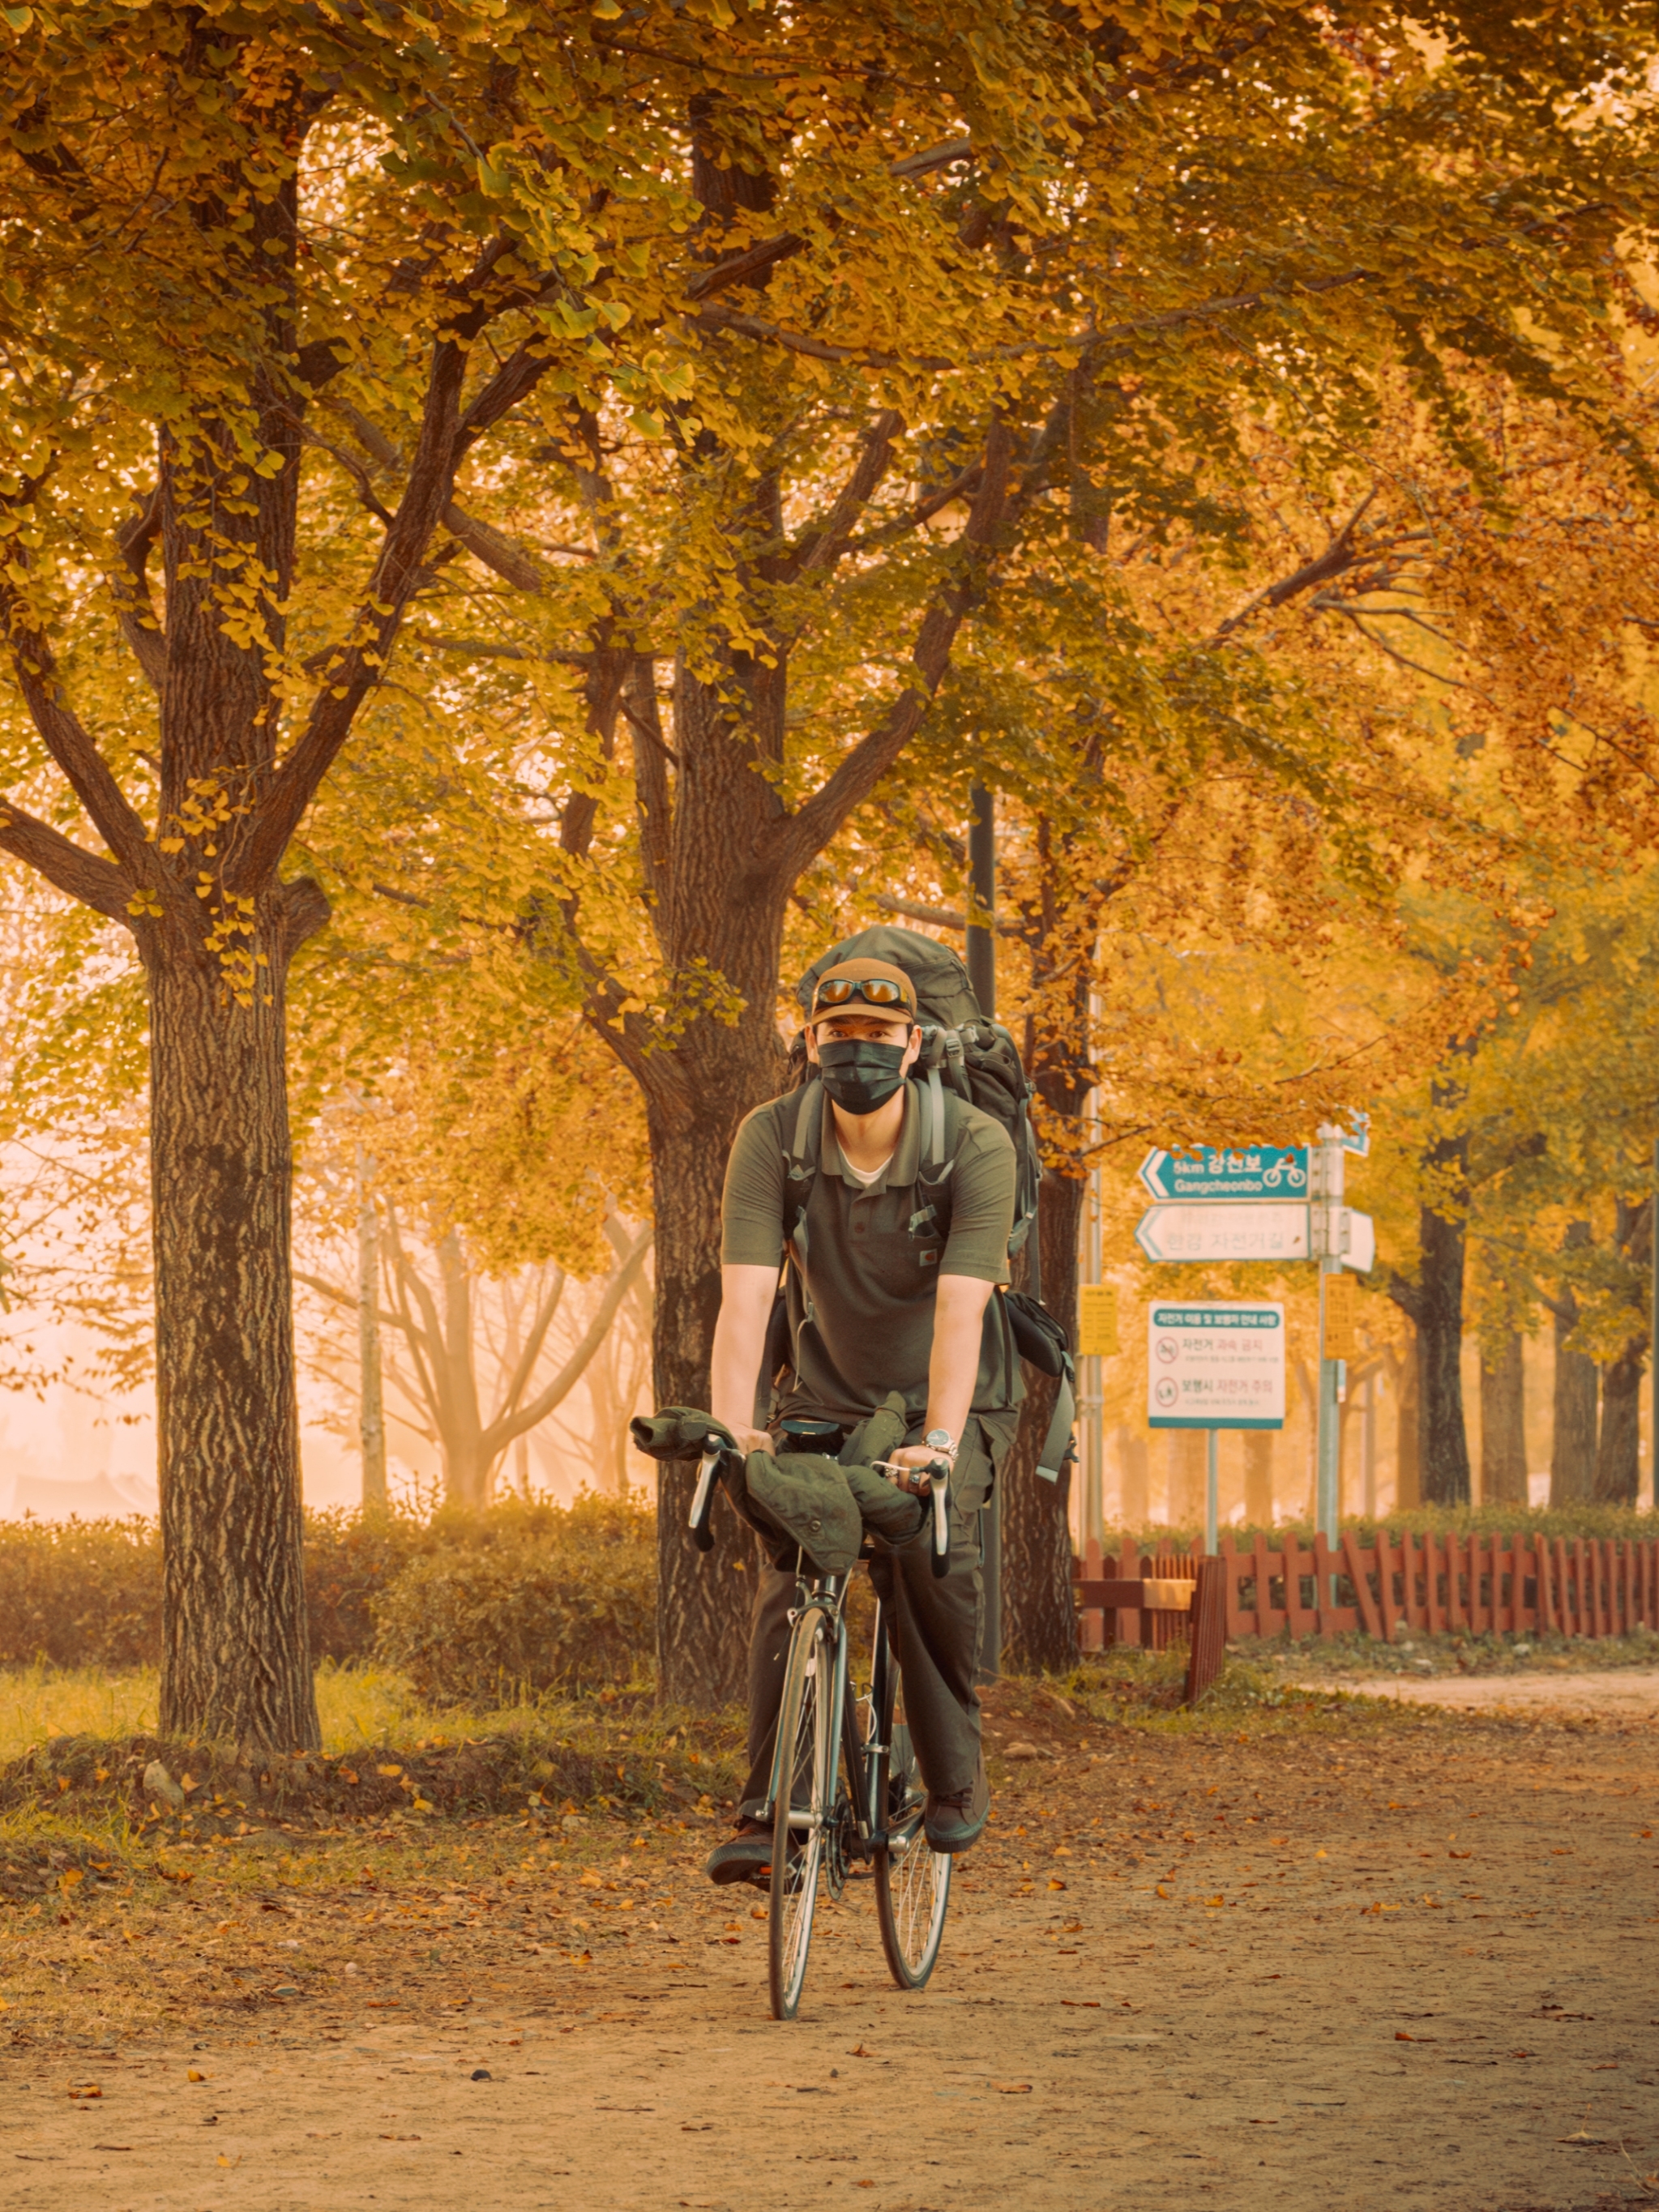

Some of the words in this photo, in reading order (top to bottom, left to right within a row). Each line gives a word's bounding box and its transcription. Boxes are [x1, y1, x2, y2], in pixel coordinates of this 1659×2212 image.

[1174, 1161, 1204, 1174] 5km
[1208, 1155, 1263, 1173] 강천보
[1175, 1180, 1263, 1194] Gangcheonbo
[1211, 1232, 1284, 1249] 자전거길
[1157, 1313, 1183, 1325] 자전거
[1182, 1338, 1213, 1352] 자전거
[1241, 1339, 1263, 1352] 금지
[1216, 1378, 1249, 1394] 자전거
[1251, 1379, 1273, 1394] 주의
